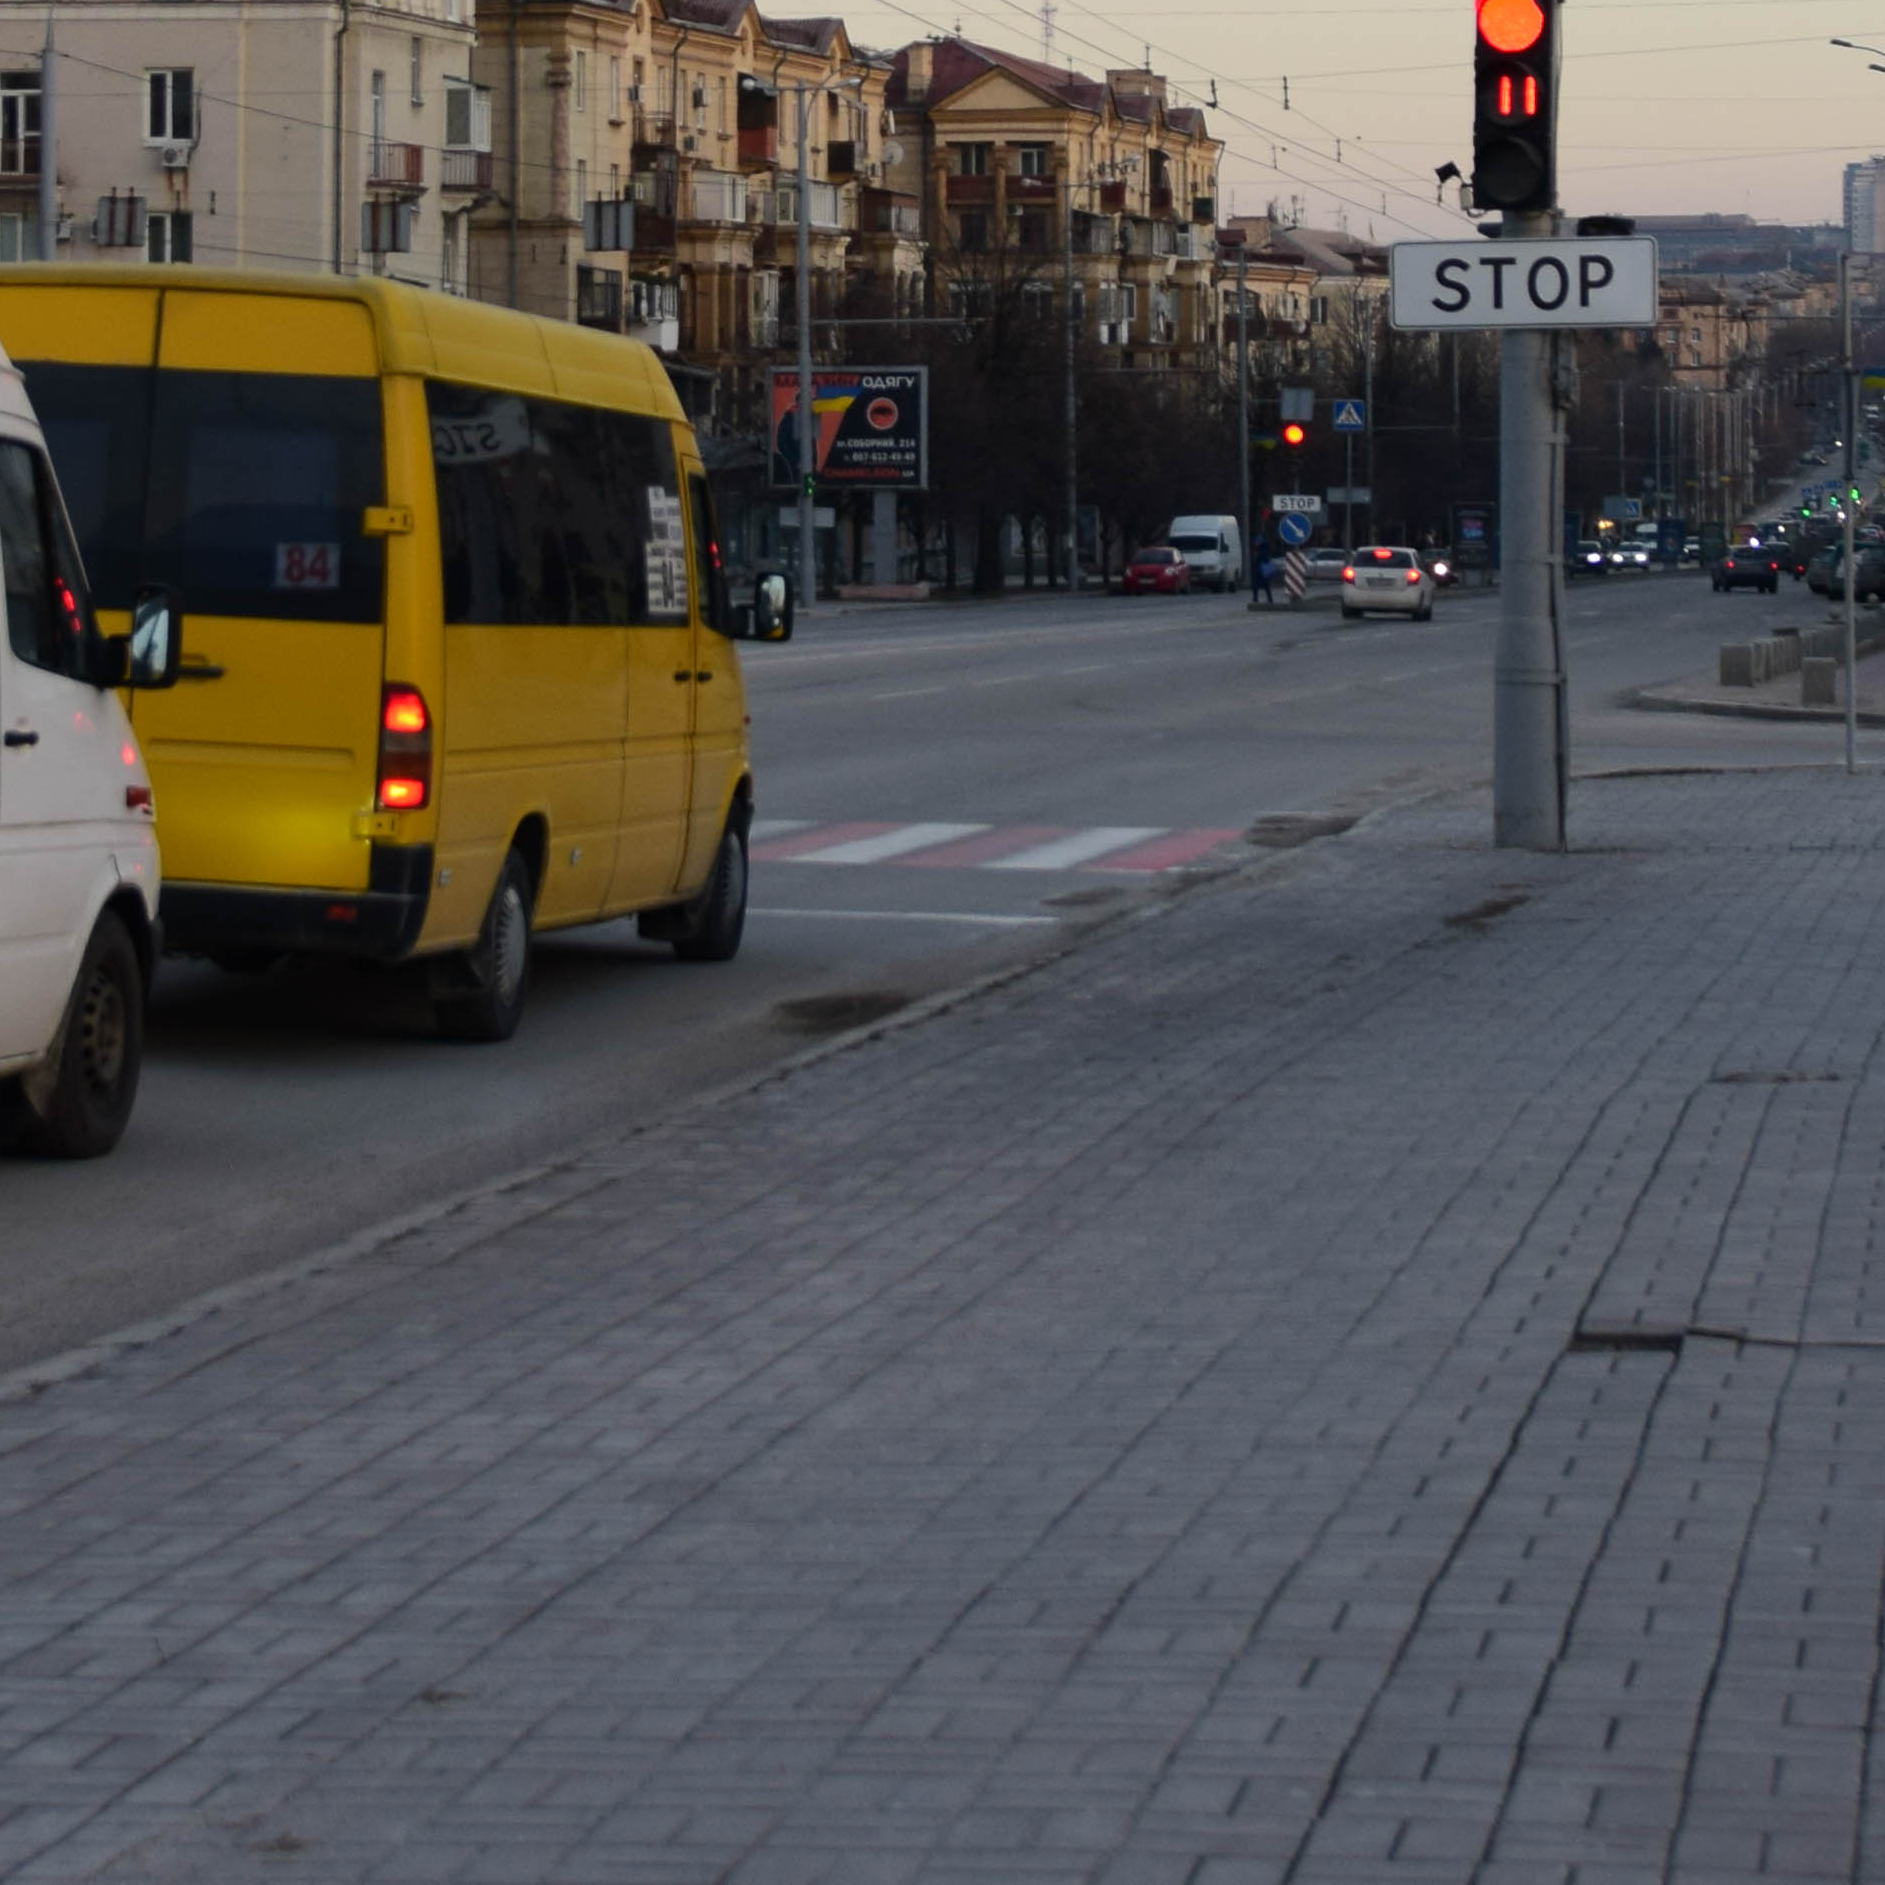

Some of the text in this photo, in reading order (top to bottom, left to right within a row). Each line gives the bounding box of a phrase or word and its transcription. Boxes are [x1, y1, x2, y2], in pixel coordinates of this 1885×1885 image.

[1432, 254, 1615, 313] STOP
[862, 376, 915, 389] ОДЯГУ
[1280, 497, 1315, 510] STOP
[285, 545, 331, 585] 84
